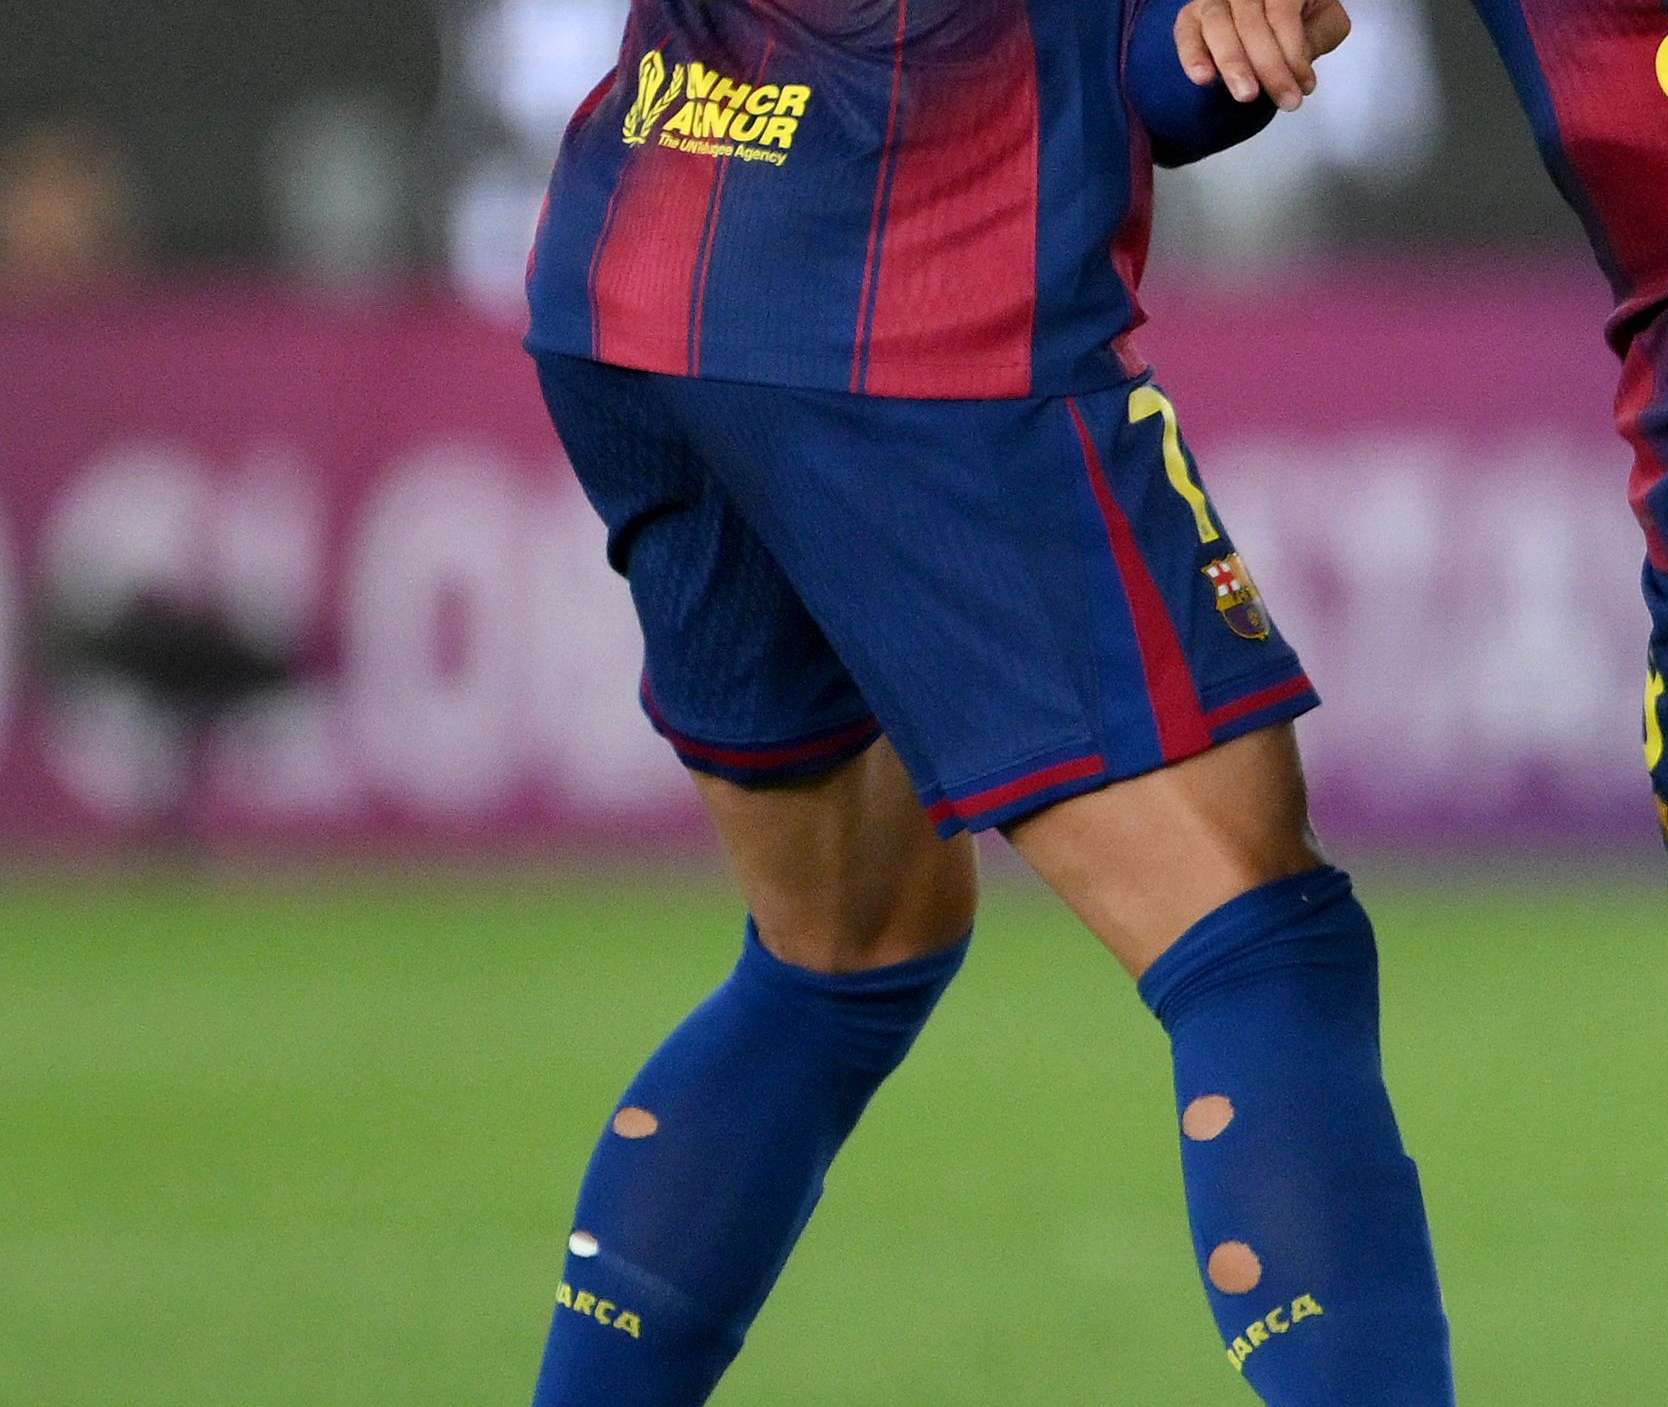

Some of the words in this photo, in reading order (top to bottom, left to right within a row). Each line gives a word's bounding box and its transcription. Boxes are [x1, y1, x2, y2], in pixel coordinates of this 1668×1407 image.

[658, 132, 680, 150] The
[734, 143, 788, 167] Agency
[1128, 385, 1220, 544] 7
